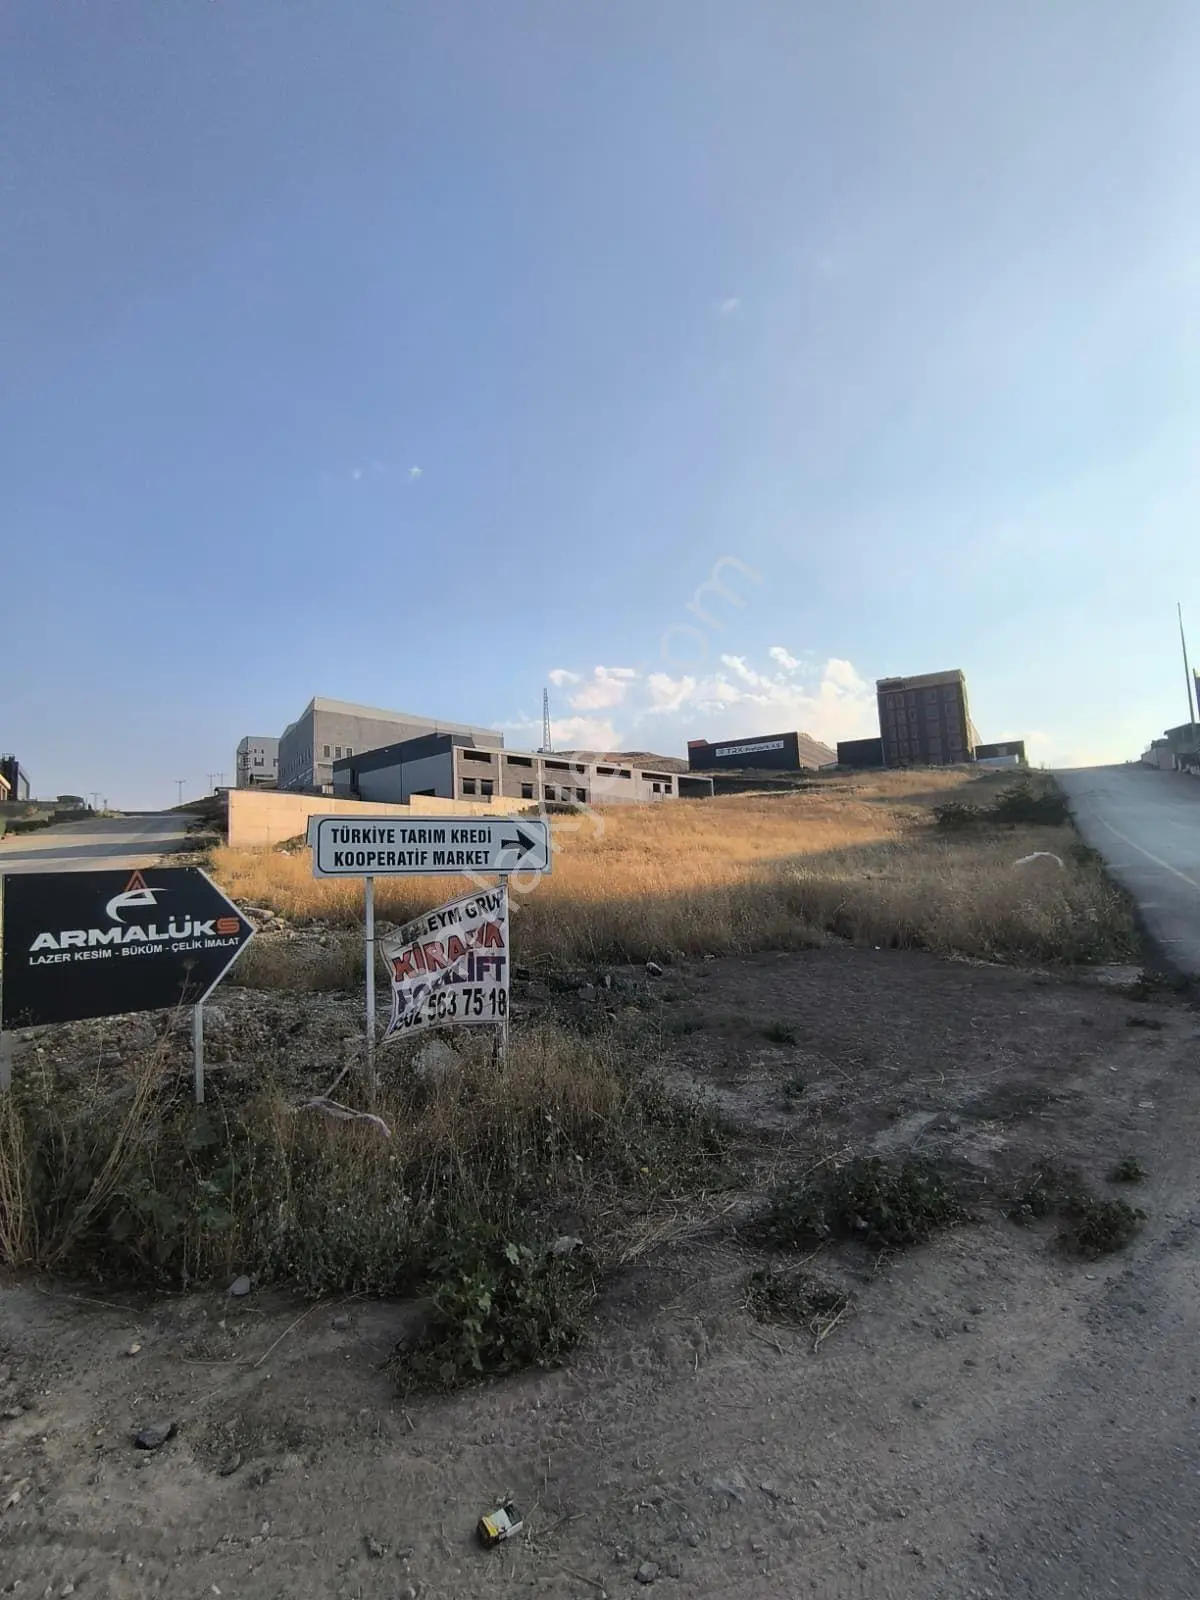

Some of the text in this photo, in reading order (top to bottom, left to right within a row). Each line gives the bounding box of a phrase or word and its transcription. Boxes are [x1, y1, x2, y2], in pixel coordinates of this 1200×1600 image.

[331, 824, 492, 844] TÜRKİYE TARIM KREDİ
[334, 847, 490, 867] KOOPERATİF MARKET
[29, 914, 240, 952] ARMALÜKS
[29, 953, 71, 966] LAZER
[74, 948, 112, 962] KESİM
[122, 943, 163, 957] BÜKÜM
[172, 939, 202, 954] ÇELİK
[204, 936, 240, 949] İMALAT
[462, 987, 483, 1016] 75
[489, 987, 507, 1017] 18
